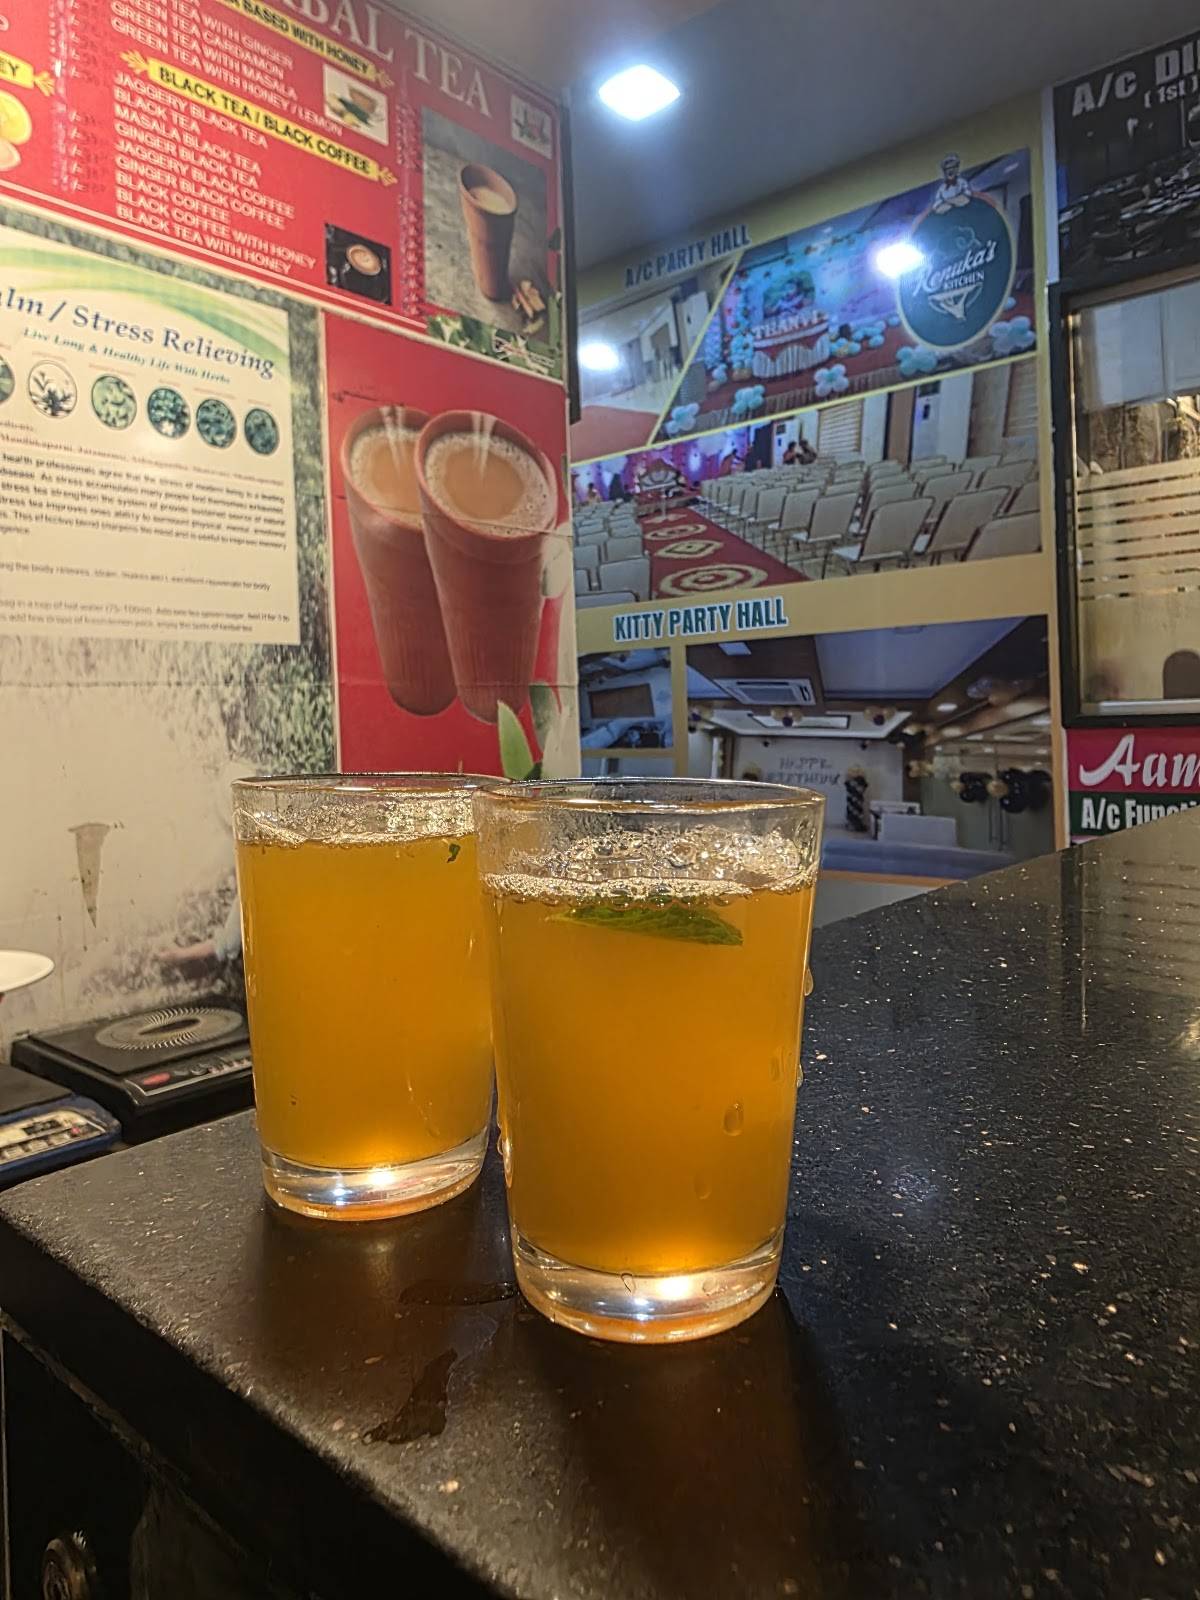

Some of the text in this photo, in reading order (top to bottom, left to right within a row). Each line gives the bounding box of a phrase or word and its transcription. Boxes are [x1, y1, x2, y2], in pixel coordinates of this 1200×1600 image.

[110, 0, 299, 101] GREEN TEA WITH MASALA
[171, 11, 201, 39] TEA
[203, 29, 285, 80] CARDAMON
[203, 13, 240, 41] WITH
[292, 22, 325, 52] WITH
[326, 46, 369, 74] HONEY
[110, 15, 169, 55] GREEN
[171, 43, 201, 70] TEA
[203, 60, 240, 88] WITH
[241, 78, 290, 112] HONEY
[299, 104, 344, 137] LEMON
[113, 85, 200, 135] BLACK TEA
[114, 70, 268, 150] JAGGERY BLACK TEA
[404, 28, 493, 118] TEA
[113, 101, 262, 177] MASALA BLACK TEA
[114, 120, 178, 158] GINGER
[178, 144, 228, 178] BLACK
[229, 164, 259, 190] TEA
[159, 66, 217, 105] BLACK
[220, 94, 252, 121] TEA
[263, 114, 314, 150] BLACK
[316, 140, 372, 175] COFFEE
[114, 138, 190, 178] JAGGERY
[190, 165, 241, 197] BLACK
[239, 186, 296, 221] COFFEE
[115, 154, 286, 231] GINGER BLACK COFFEE
[115, 169, 231, 223] BLACK COFFEE
[115, 186, 318, 271] BLACK COFFEE WITH HONEY
[115, 202, 292, 276] BLACK TEA WITH HONEY
[656, 238, 707, 275] PARTY
[710, 223, 751, 255] HALL
[912, 238, 998, 298] Renuka's
[23, 326, 49, 340] Live
[53, 334, 85, 351] Long
[102, 345, 147, 368] Healthy
[72, 304, 155, 346] Stress
[162, 325, 276, 382] Relieving
[614, 597, 788, 641] KITTY PARTY HALL
